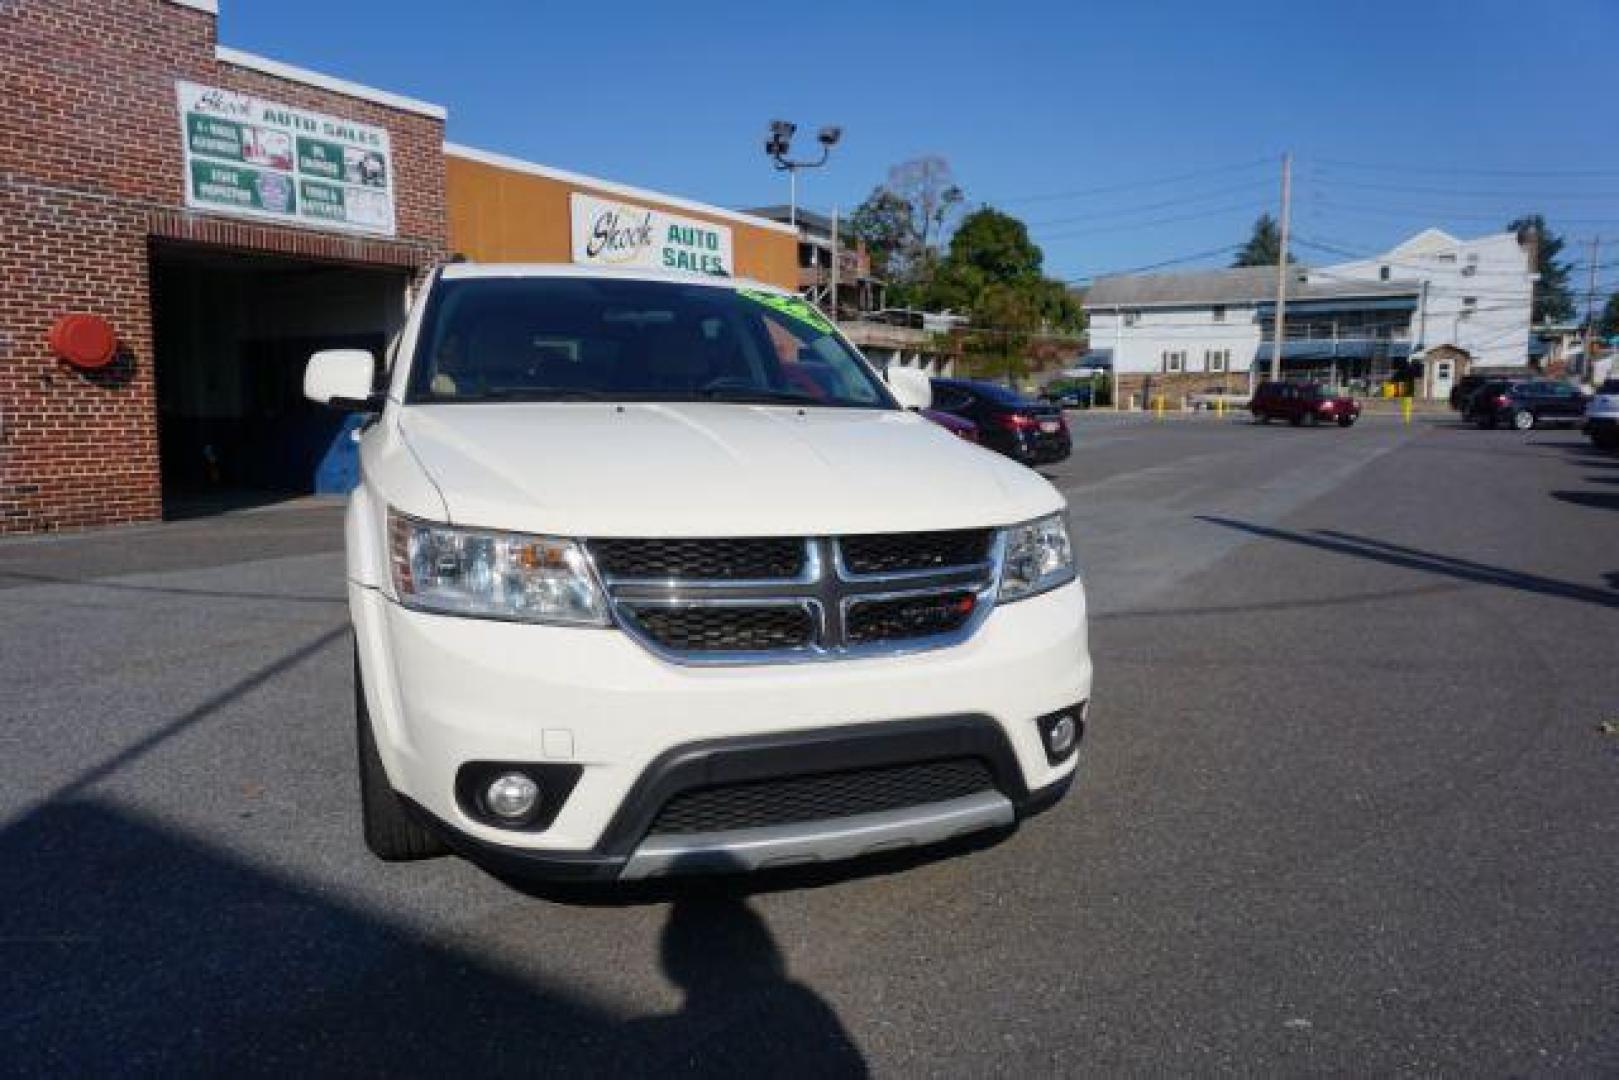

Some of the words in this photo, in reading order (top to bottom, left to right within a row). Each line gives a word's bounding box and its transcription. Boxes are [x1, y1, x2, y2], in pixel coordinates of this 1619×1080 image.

[264, 108, 317, 131] AUTO
[323, 123, 380, 145] SALES
[668, 224, 718, 251] AUTO
[662, 247, 722, 273] SALES
